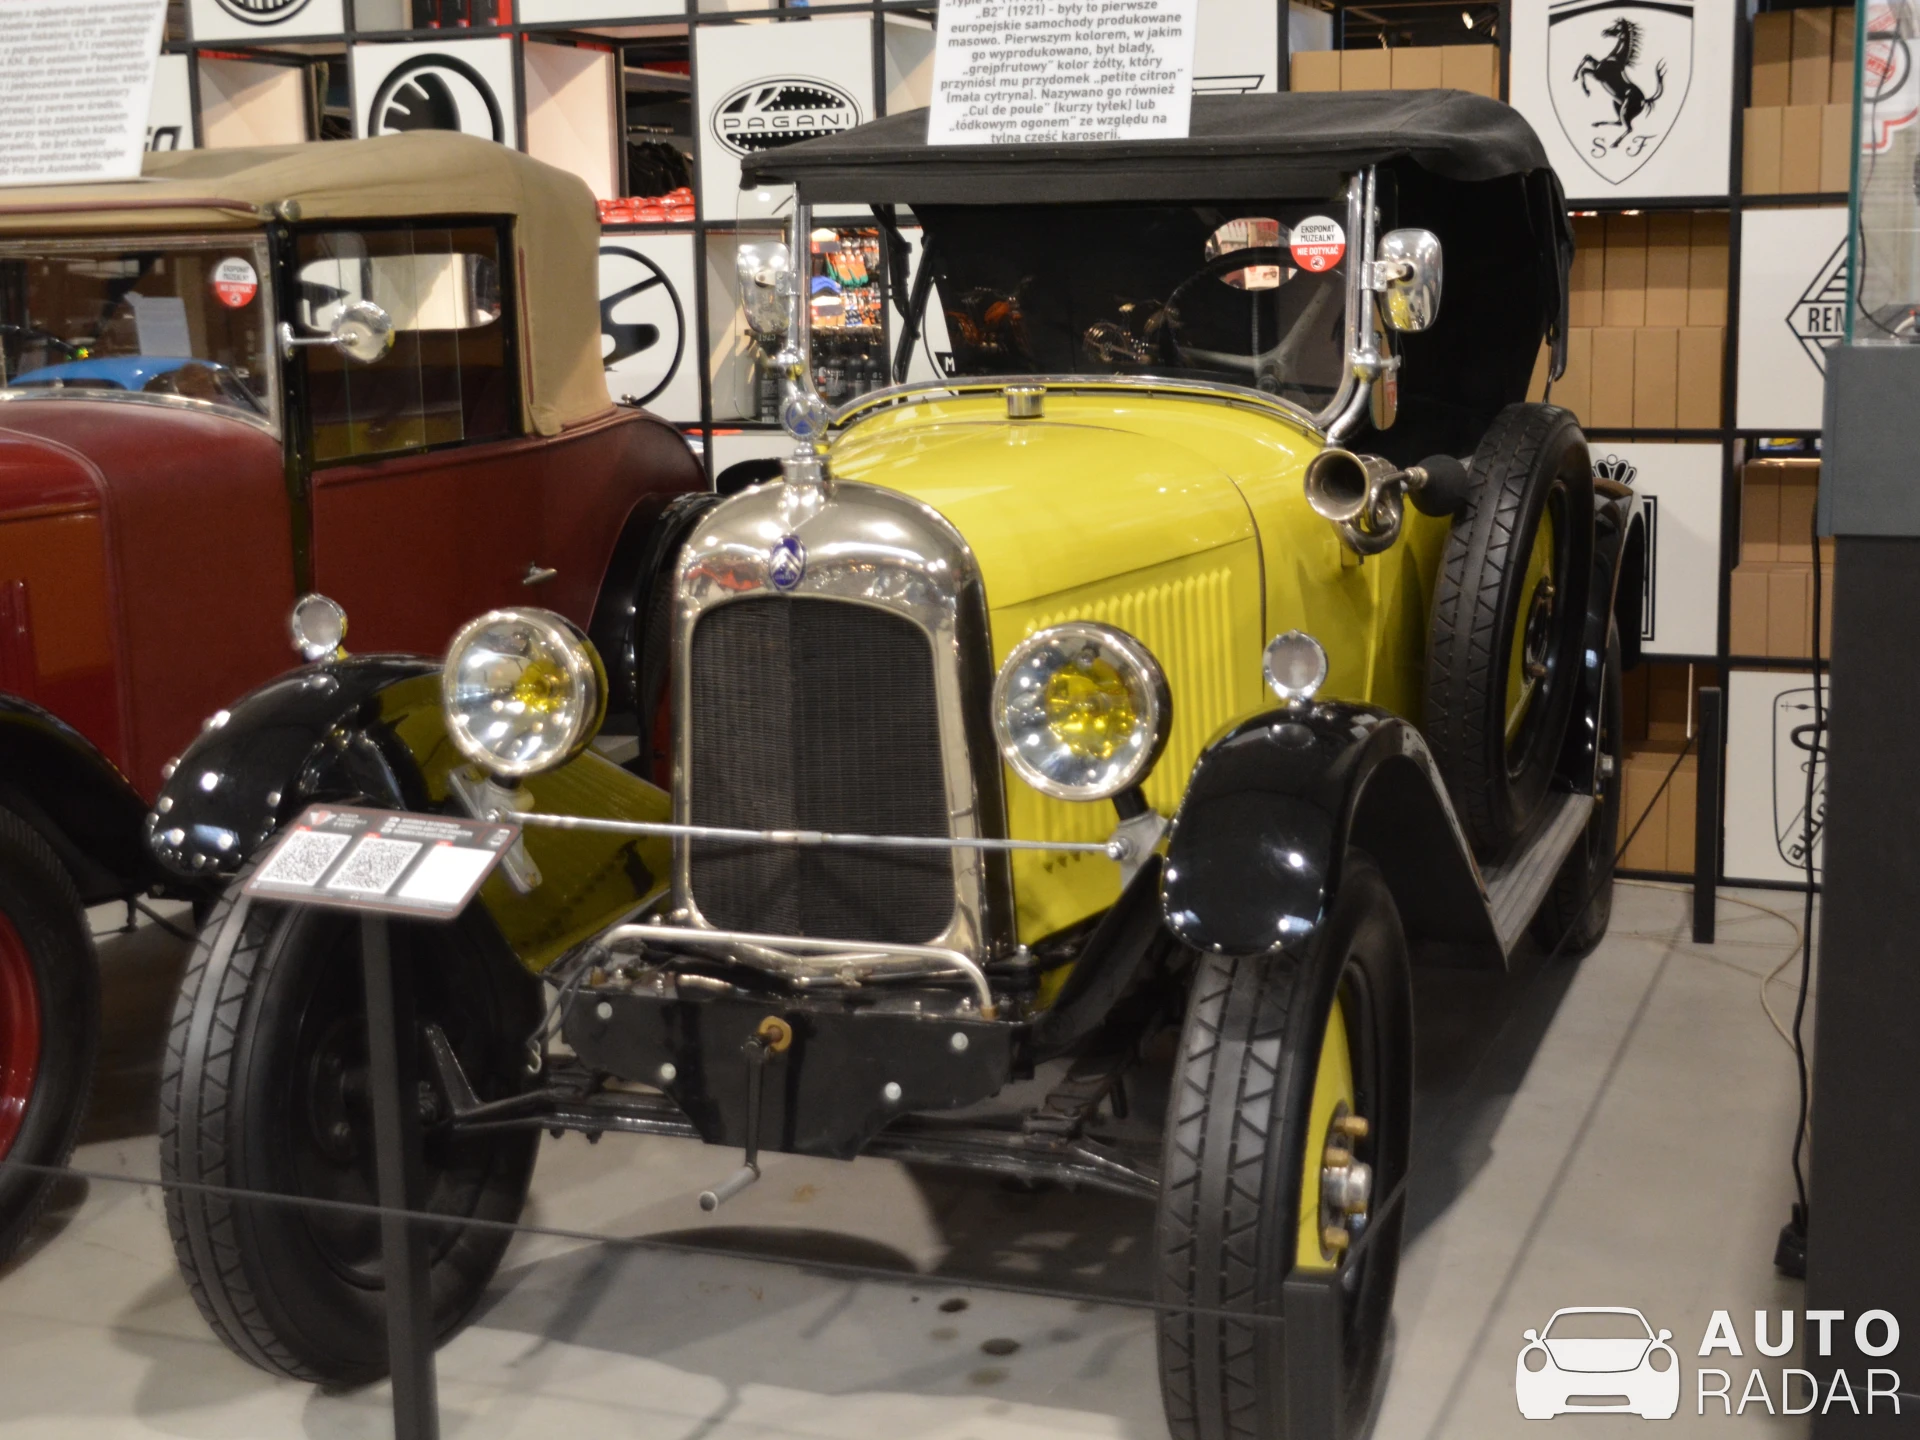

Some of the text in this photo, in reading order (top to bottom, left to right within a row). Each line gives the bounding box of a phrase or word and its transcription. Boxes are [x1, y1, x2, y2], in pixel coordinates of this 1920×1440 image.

[1007, 3, 1045, 17] (1921)
[1057, 4, 1084, 18] były
[1086, 3, 1098, 13] to
[1101, 0, 1158, 15] pierwsze
[950, 13, 1182, 34] europejskie samochody produkowane
[948, 26, 1182, 47] masowo. Pierwszym kolorem, w jakim
[971, 41, 1155, 63] go wyprodukowano, był blady,
[1057, 59, 1090, 70] kolor
[1092, 57, 1126, 72] żółty,
[1129, 55, 1162, 70] który
[940, 75, 996, 91] przyniósł
[999, 78, 1019, 87] mu
[1022, 74, 1090, 89] przydomek
[946, 91, 981, 104] (mała
[1041, 86, 1104, 103] Nazywano
[1107, 88, 1122, 100] go
[1125, 83, 1175, 97] również
[992, 104, 1007, 115] de
[1053, 100, 1093, 115] (kurzy
[1096, 98, 1132, 114] tyłek)
[1135, 98, 1156, 110] lub
[723, 112, 849, 131] PAGANI
[1079, 118, 1093, 127] ze
[1096, 113, 1149, 129] względu
[1152, 115, 1167, 124] na
[1061, 128, 1121, 141] karoserii.
[1301, 224, 1335, 233] EKSPONAT
[1300, 234, 1335, 242] MUZEALNY
[1297, 244, 1339, 255] NIE DOTYKAĆ
